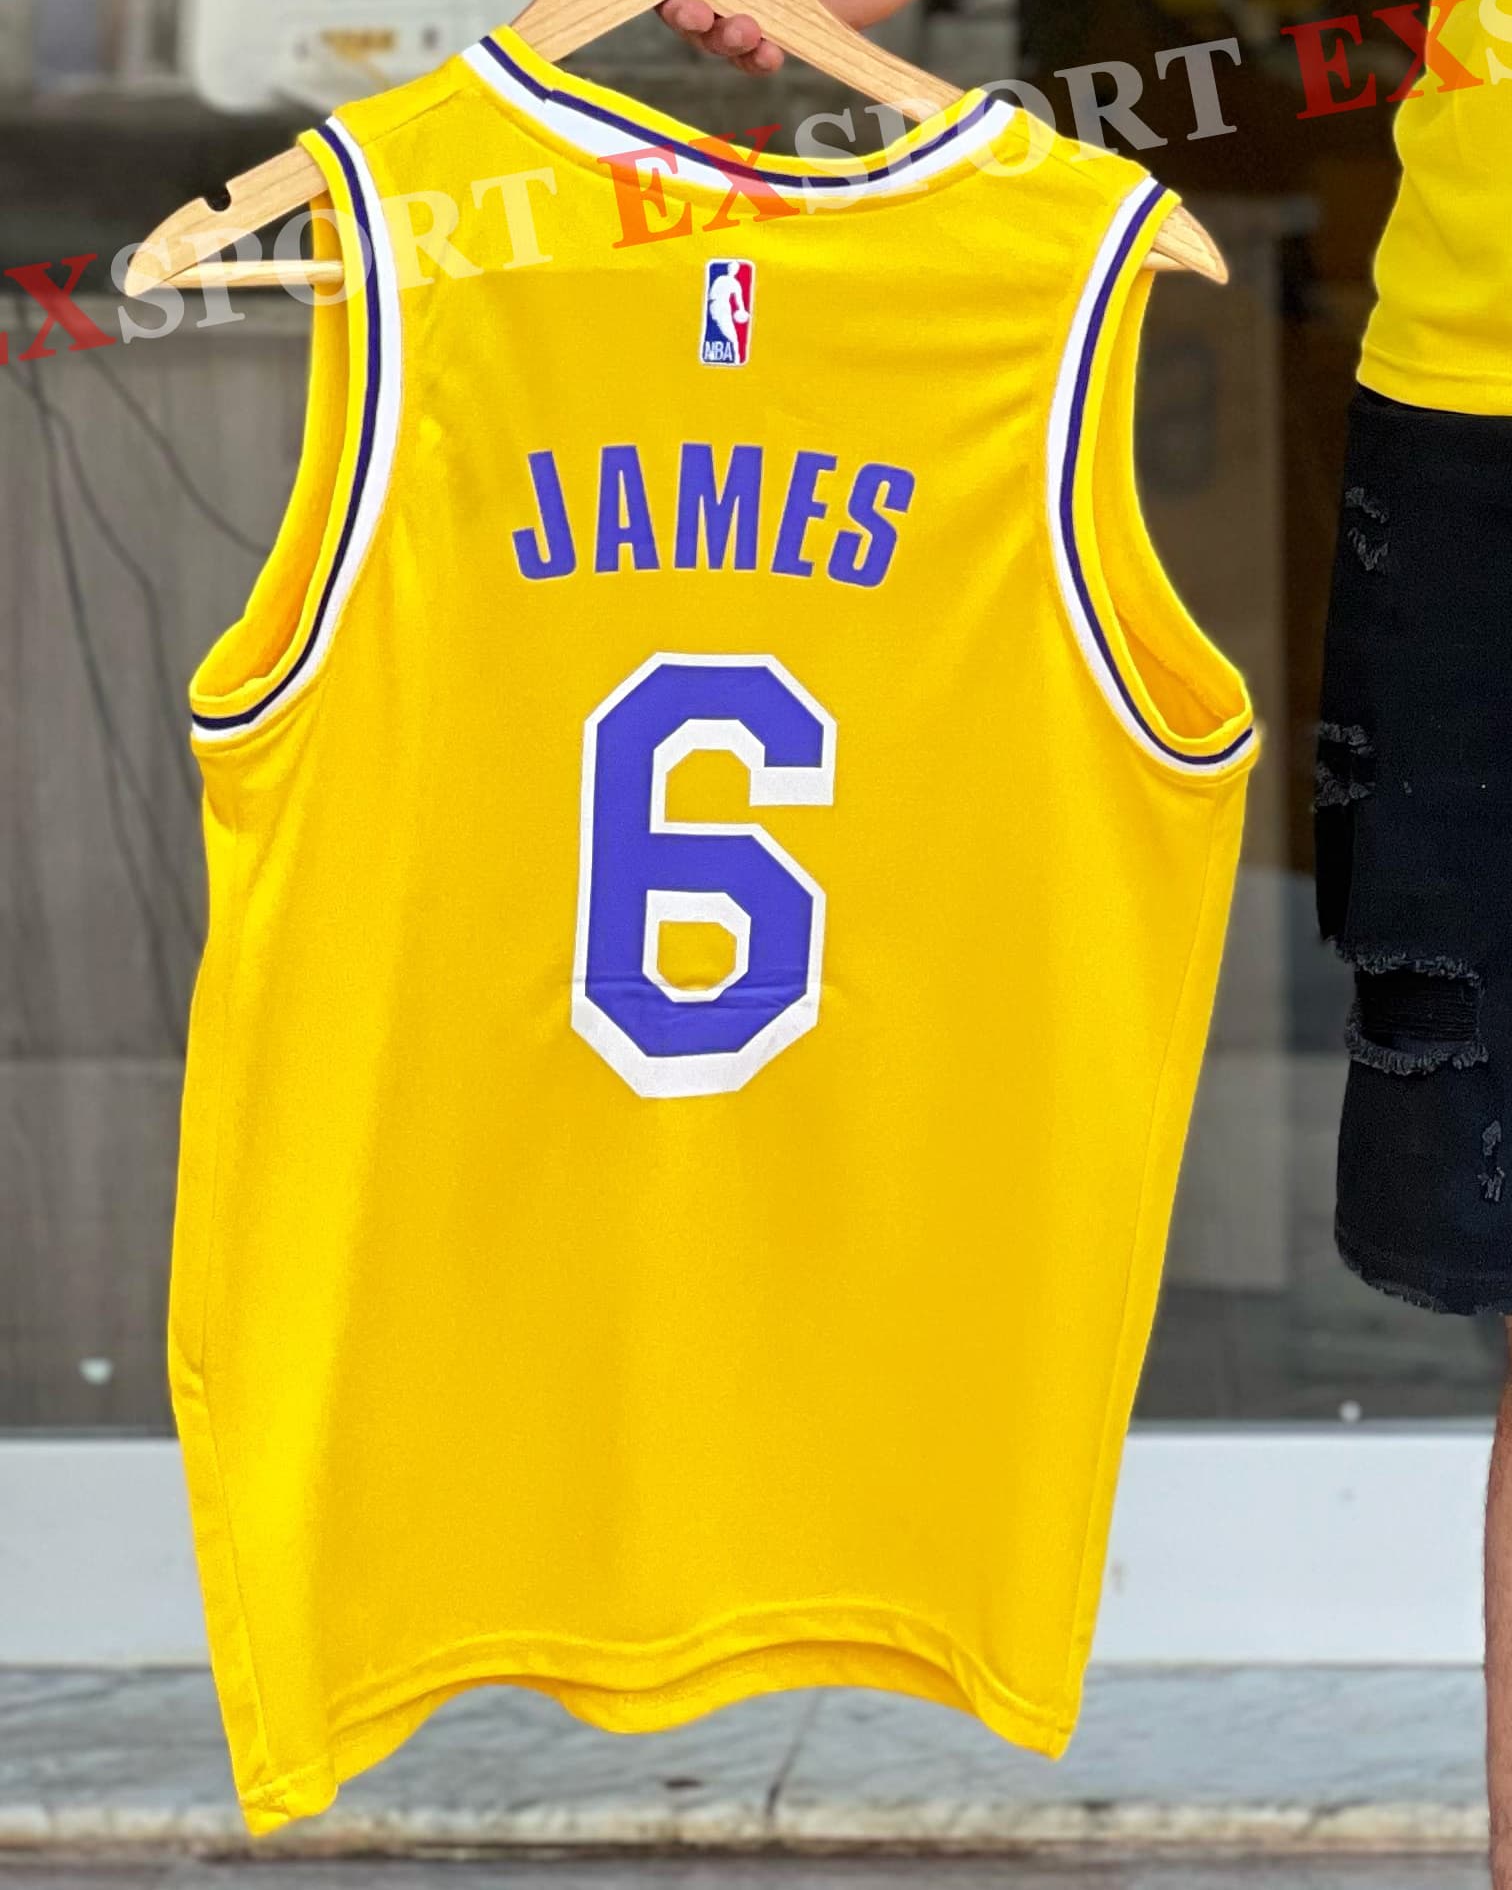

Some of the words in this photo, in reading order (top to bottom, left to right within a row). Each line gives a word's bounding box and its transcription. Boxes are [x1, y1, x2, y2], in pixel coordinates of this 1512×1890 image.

[704, 340, 733, 362] NBA
[511, 442, 917, 589] JAMES
[570, 652, 838, 1099] 6
